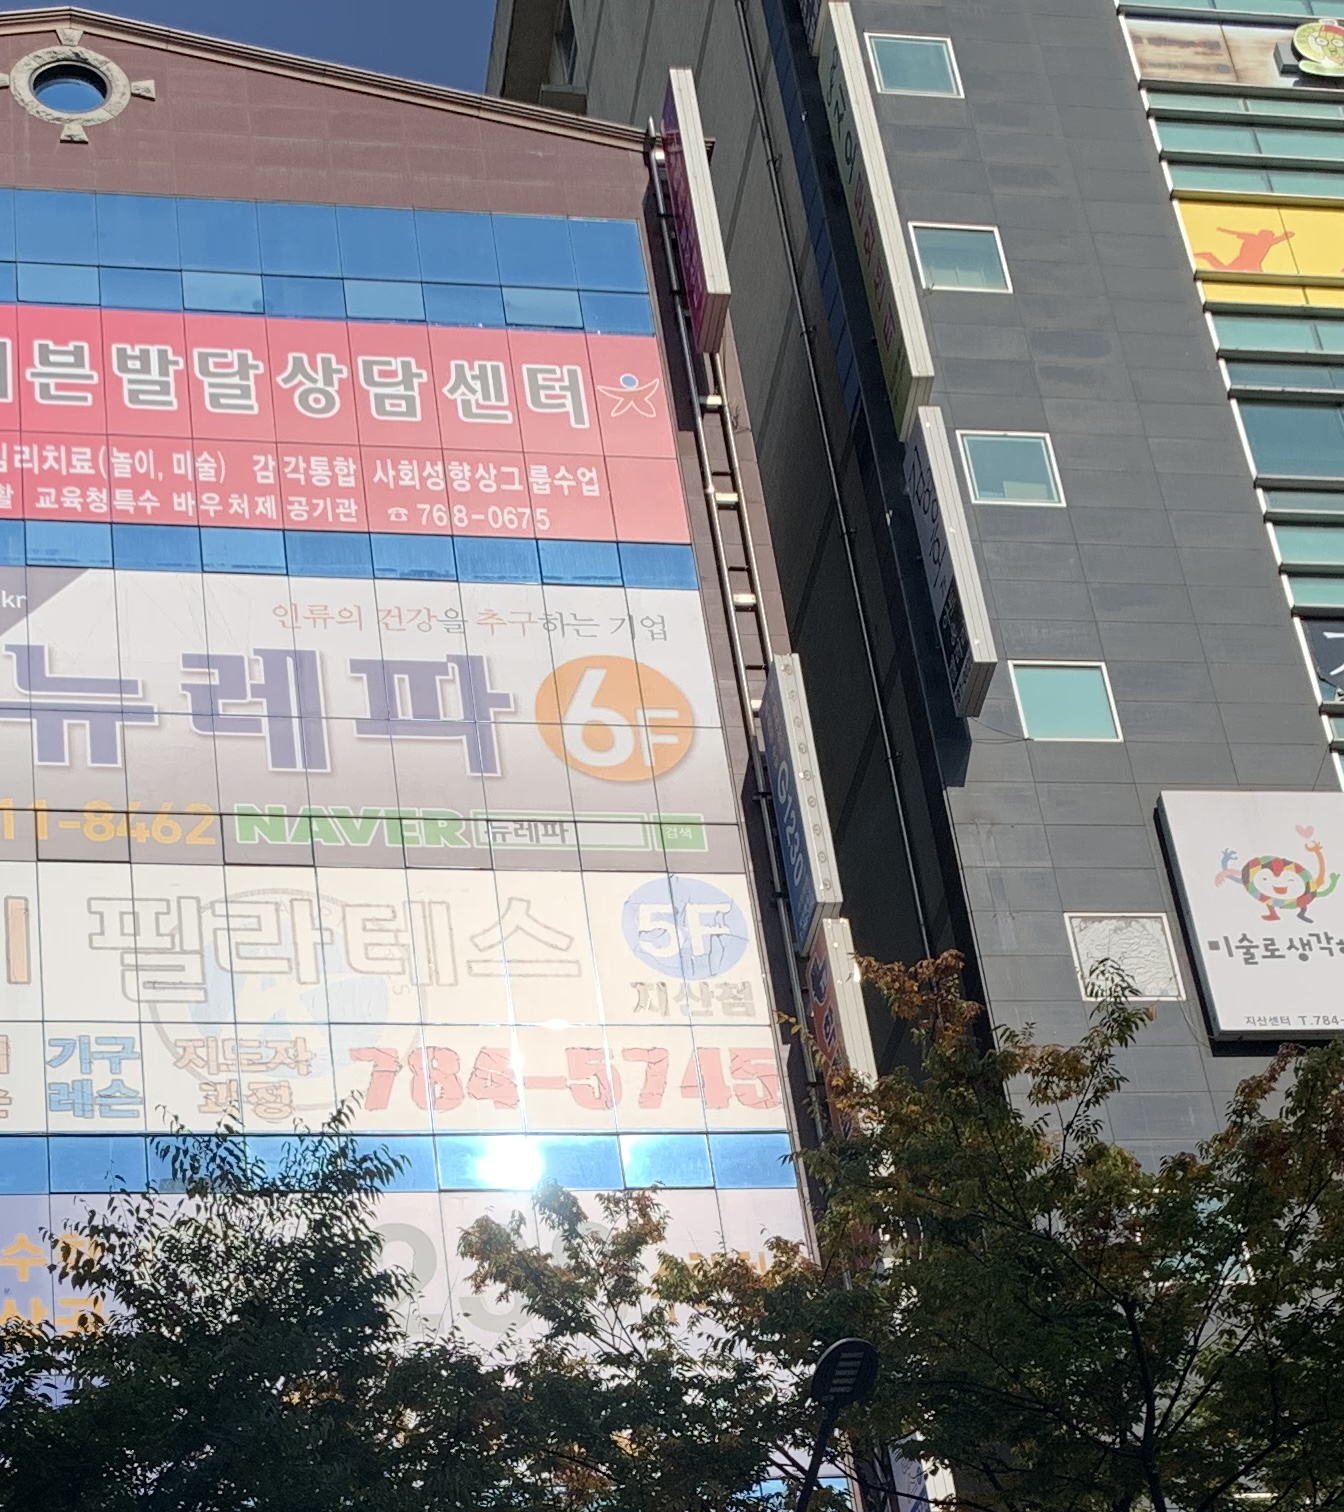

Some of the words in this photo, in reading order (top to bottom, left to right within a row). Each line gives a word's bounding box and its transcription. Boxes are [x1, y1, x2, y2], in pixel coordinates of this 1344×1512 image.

[253, 452, 357, 488] 감각통합
[372, 459, 601, 497] 사회성향상그룹수업
[35, 485, 161, 517] 교육청특수
[286, 499, 358, 524] 공기관
[420, 503, 552, 531] 768-0675
[272, 603, 364, 633] 인류의
[377, 606, 467, 636] 건강을
[475, 609, 600, 639] 추구하는
[608, 613, 668, 642] 기업
[557, 668, 680, 768] 6F
[232, 803, 471, 849] NAVER
[483, 819, 569, 846] 뉴레파
[664, 826, 694, 841] 검색
[776, 757, 805, 888] G1230
[86, 896, 582, 1004] 필라테스
[635, 900, 739, 960] 5F
[1245, 1014, 1293, 1027] 지산센터
[47, 1035, 141, 1075] 기구
[173, 1036, 314, 1076] 지도자
[48, 1079, 143, 1119] 레슨
[349, 1047, 782, 1111] 784-5745
